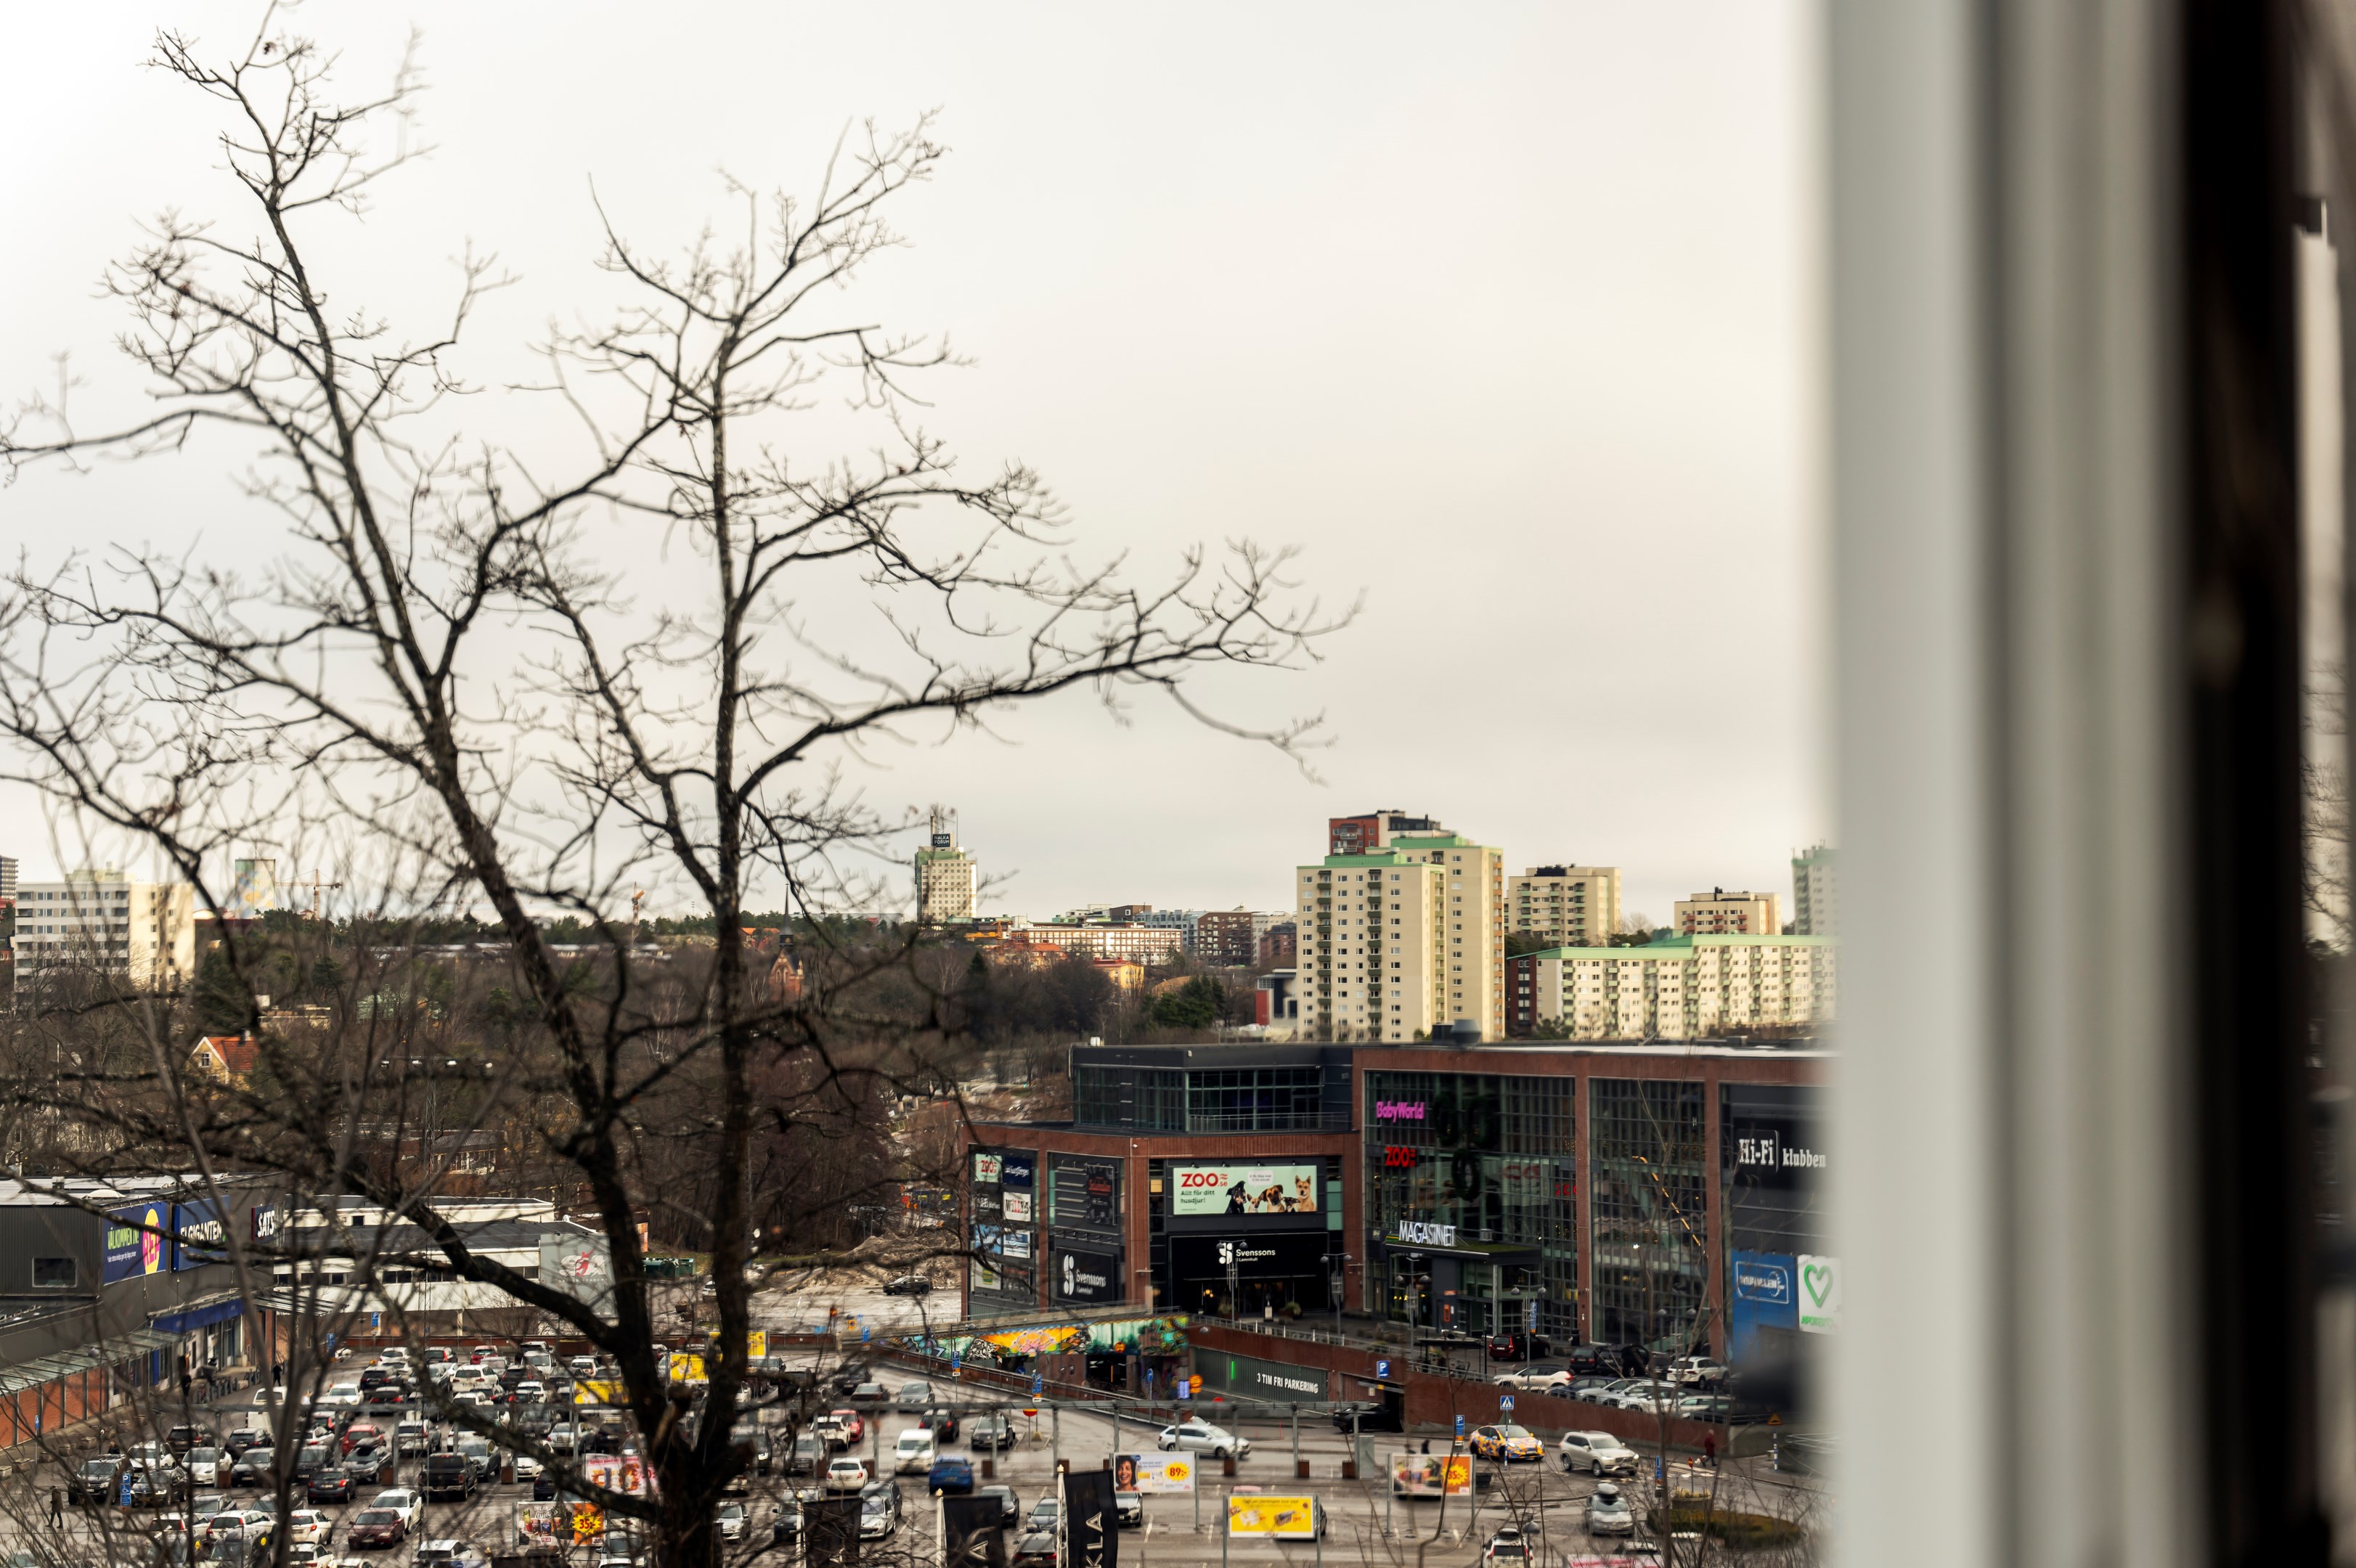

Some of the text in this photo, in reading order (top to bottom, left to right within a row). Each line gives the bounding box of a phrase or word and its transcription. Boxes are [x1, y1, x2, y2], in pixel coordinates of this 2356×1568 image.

[1377, 1101, 1424, 1123] BabyWorld
[1739, 1138, 1827, 1167] Hi-Fi klubben
[181, 1220, 222, 1248] ELGIGANTEN
[258, 1210, 275, 1238] SATS
[1076, 1268, 1106, 1287] Svenssons
[1258, 1373, 1318, 1394] 3 TIM FRI PARKERING
[1170, 1467, 1186, 1477] 89:-
[579, 1519, 595, 1529] 35:-
